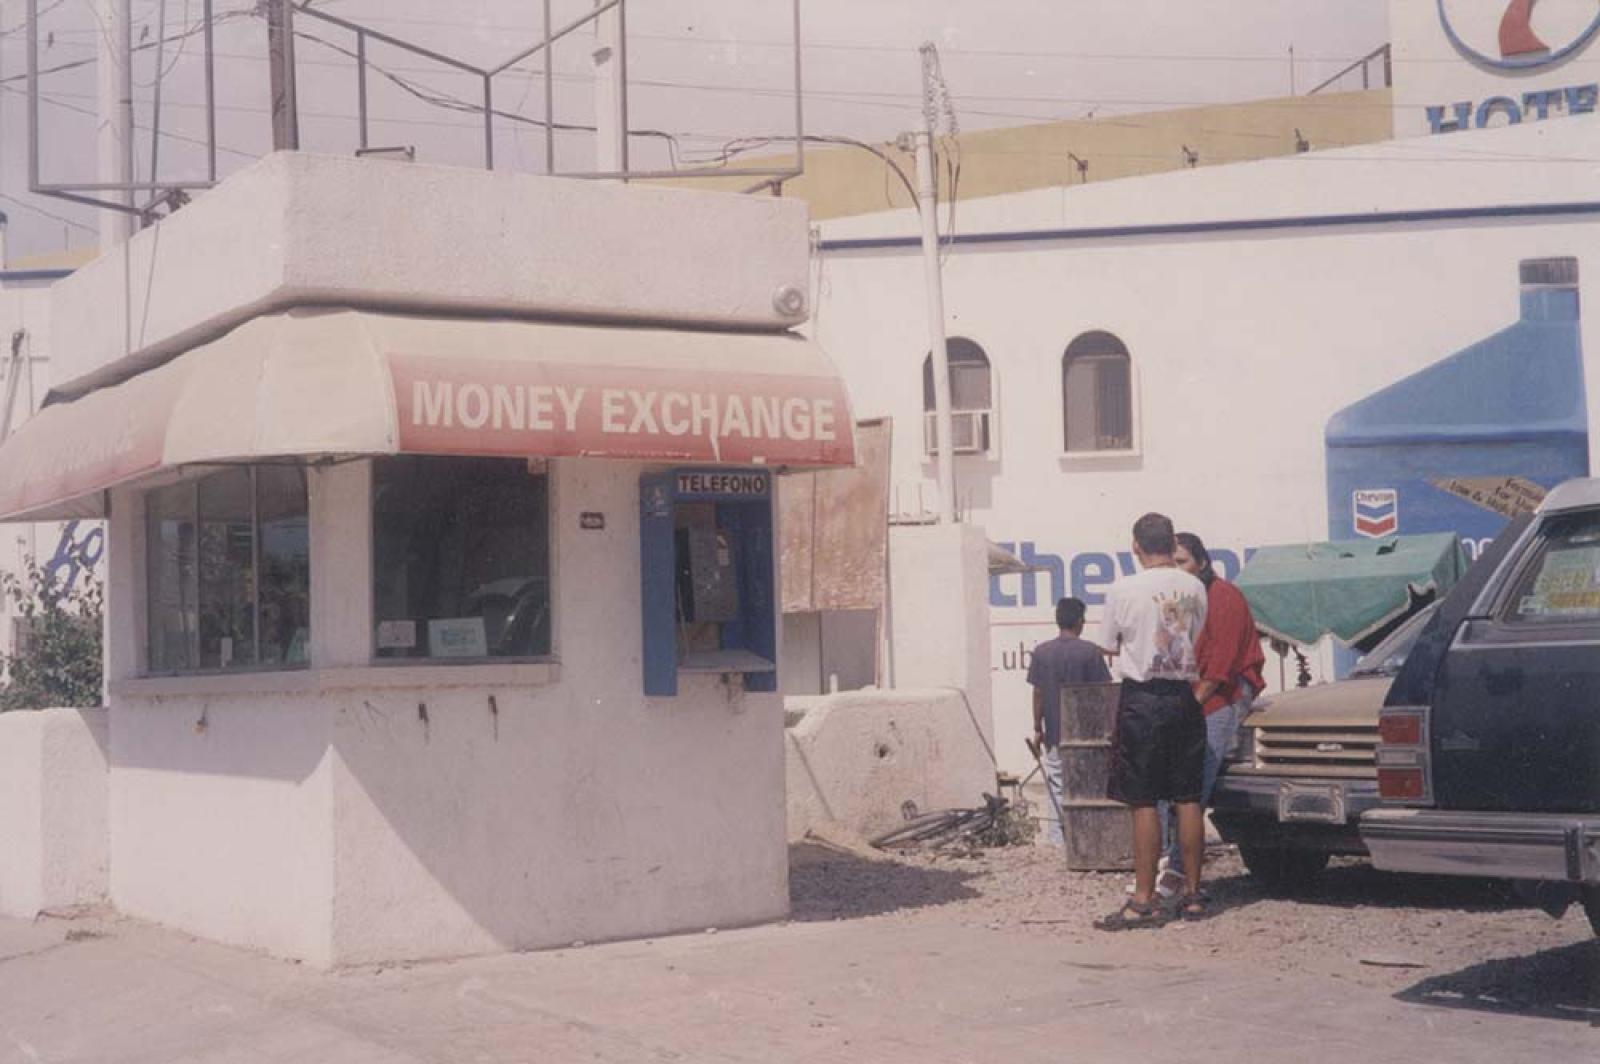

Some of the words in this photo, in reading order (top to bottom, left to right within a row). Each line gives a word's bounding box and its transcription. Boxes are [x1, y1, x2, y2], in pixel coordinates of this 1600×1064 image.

[411, 381, 585, 431] MONEY
[602, 388, 836, 440] EXCHANGE
[679, 475, 765, 492] TELEFONO
